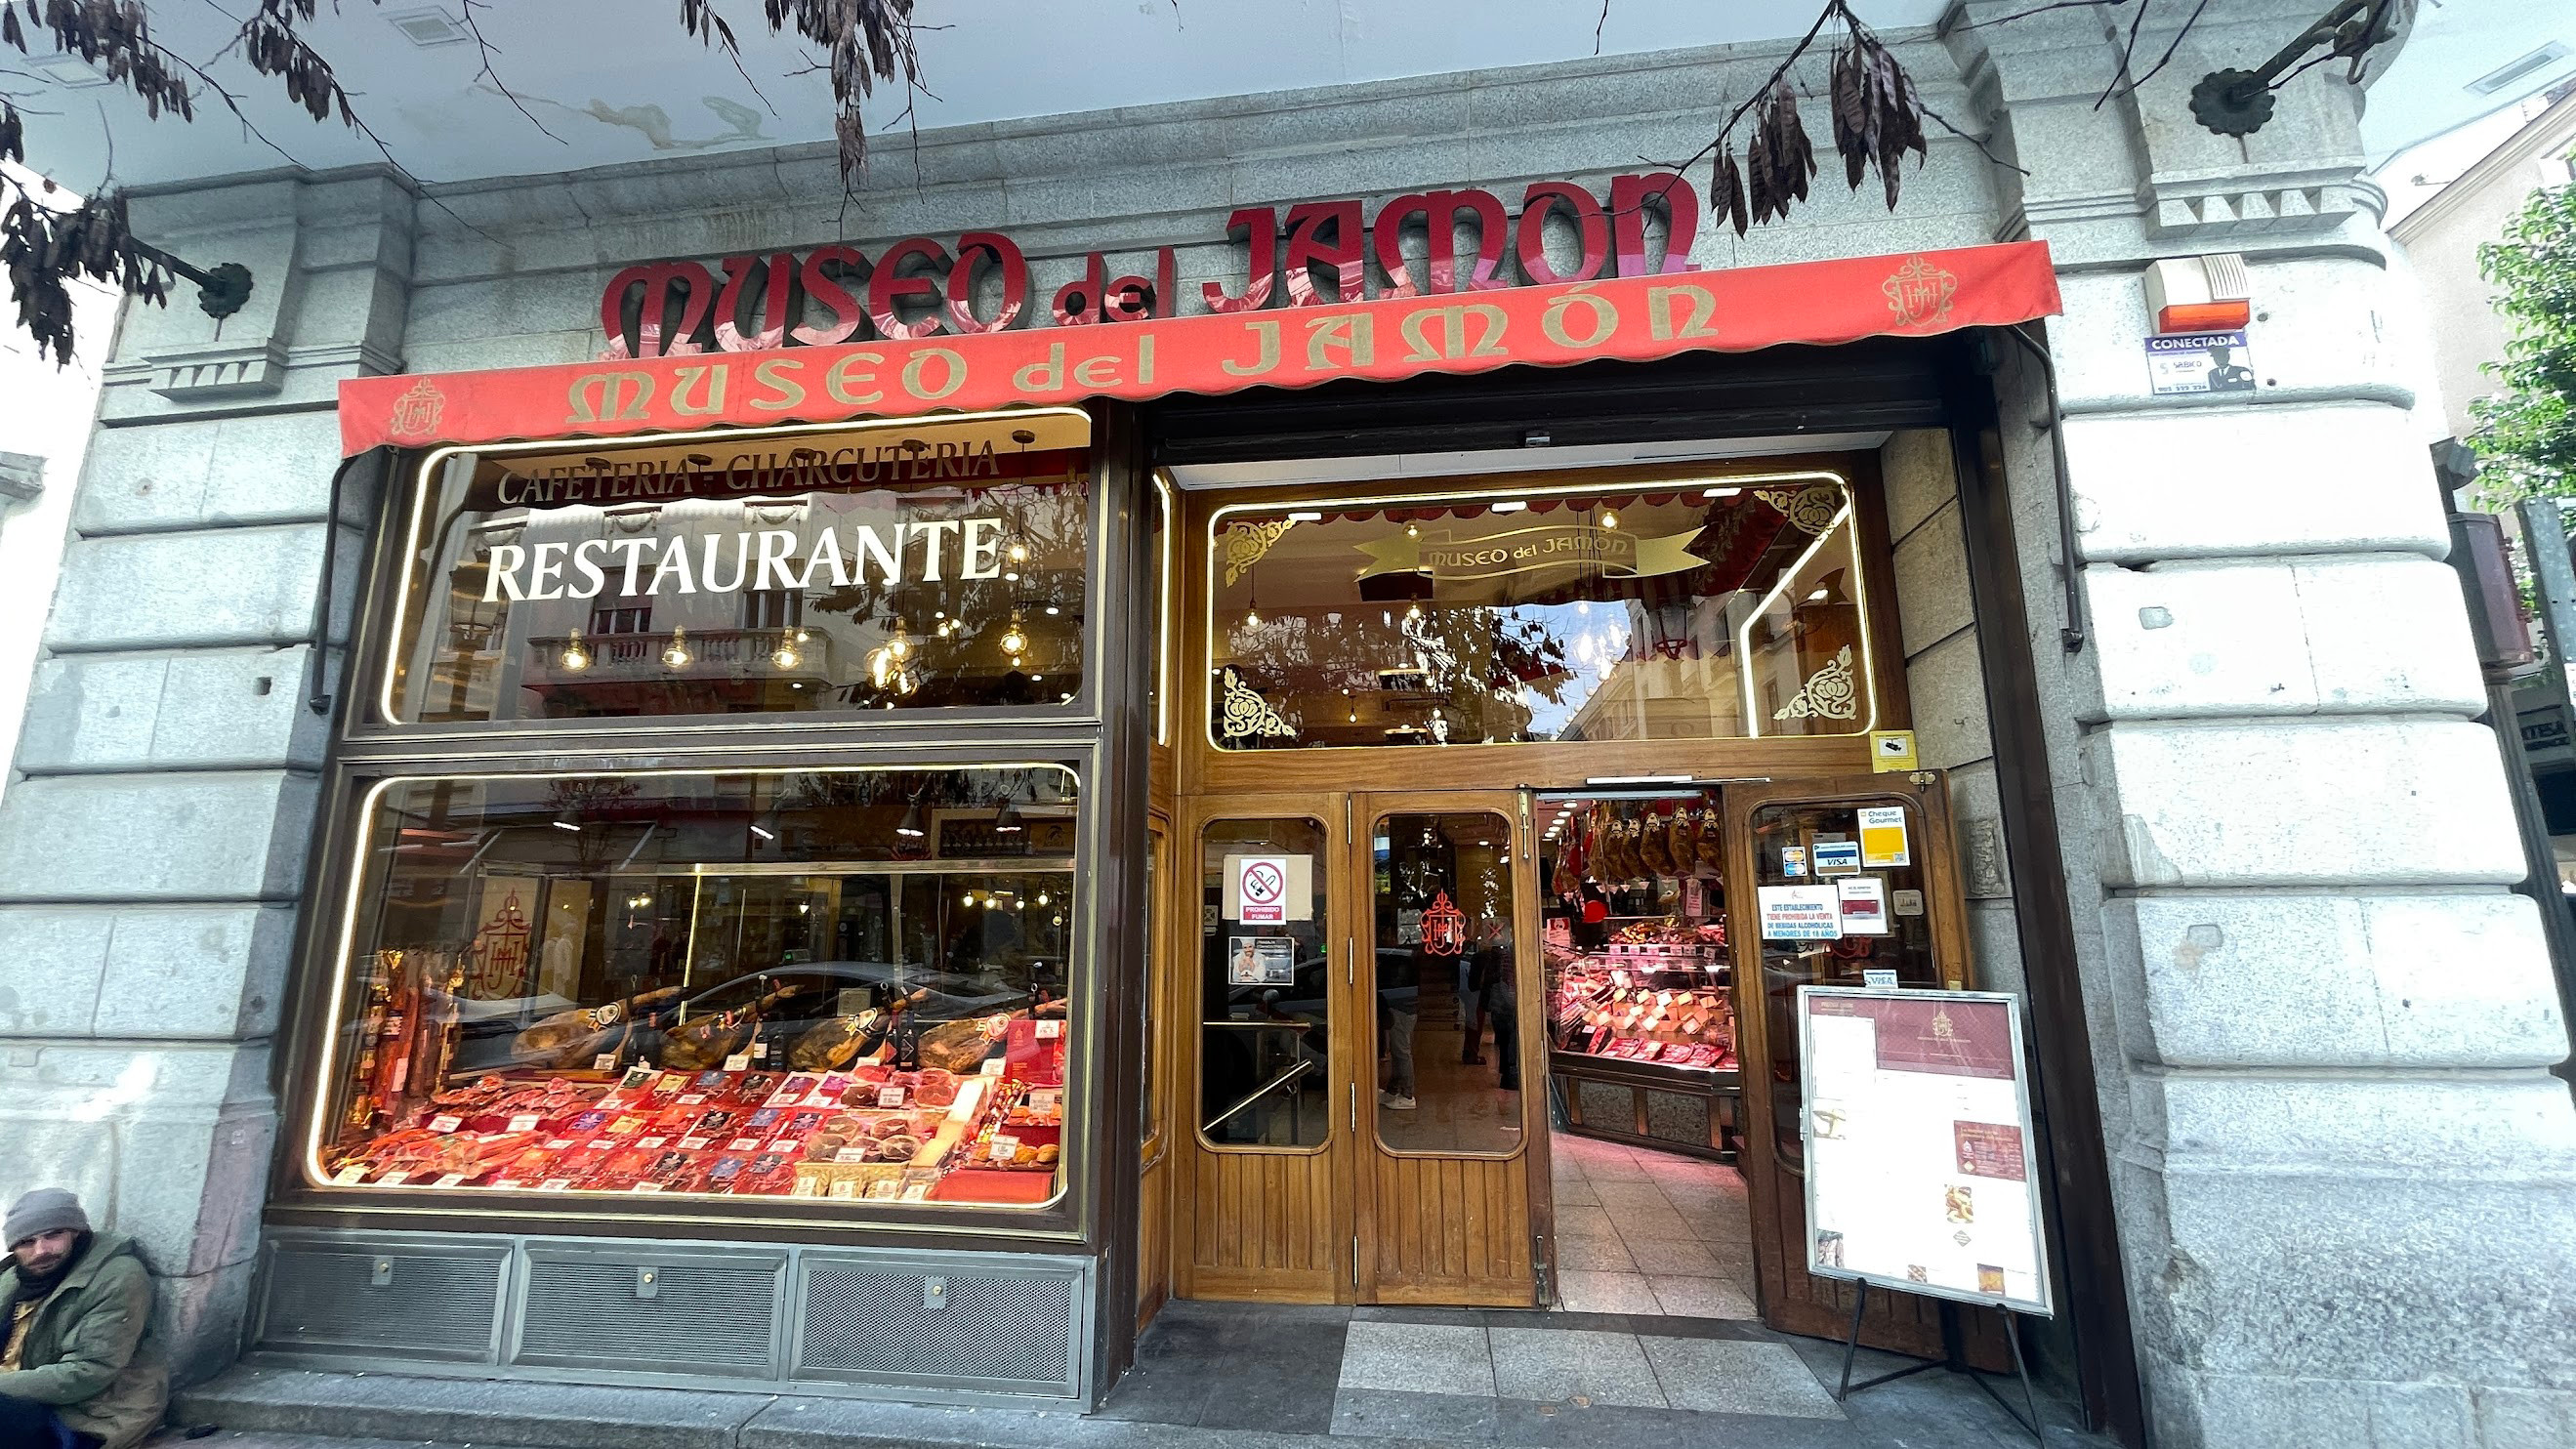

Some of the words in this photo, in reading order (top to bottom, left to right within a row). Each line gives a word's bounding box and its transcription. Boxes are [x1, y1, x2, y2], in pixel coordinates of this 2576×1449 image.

[600, 231, 1028, 359] MUSEO
[1053, 249, 1175, 325] del
[565, 348, 969, 425] MUSEO
[1013, 334, 1155, 392] del
[1222, 281, 1720, 377] JAMÓN
[2151, 336, 2240, 350] CONECTADA
[498, 458, 694, 505] CAFETERIA
[726, 439, 1000, 490] CHARCUTERIA
[481, 518, 1003, 602] RESTAURANTE
[1429, 548, 1509, 567] MUSEO
[1514, 544, 1538, 559] del
[1542, 535, 1629, 556] JAMON
[1820, 929, 1838, 937] AÑOS
